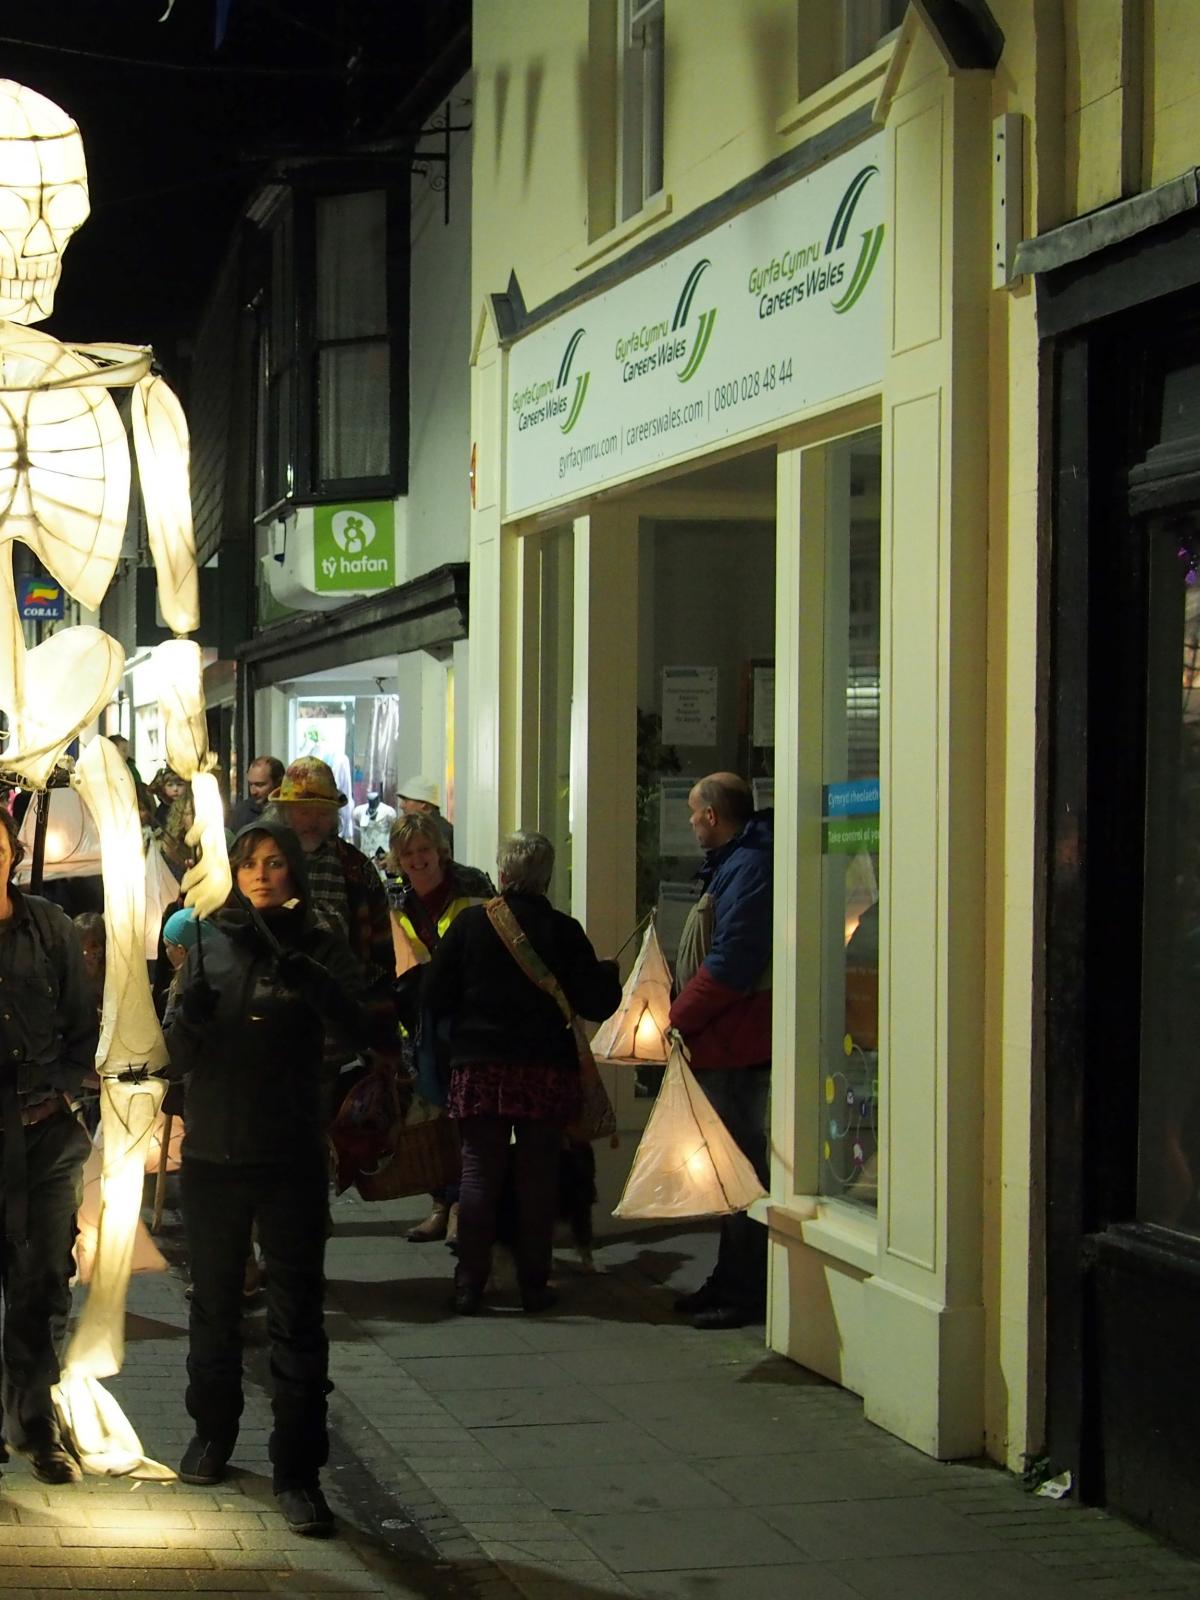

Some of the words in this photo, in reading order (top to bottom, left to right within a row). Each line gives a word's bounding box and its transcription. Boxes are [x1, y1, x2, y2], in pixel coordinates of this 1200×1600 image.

[626, 399, 704, 446] careerswales.com
[714, 381, 739, 412] 0800
[741, 370, 760, 402] 028
[762, 363, 777, 393] 48
[779, 356, 793, 386] 44
[321, 556, 337, 579] tŷ
[340, 555, 388, 574] hafan
[23, 607, 59, 617] CORAL
